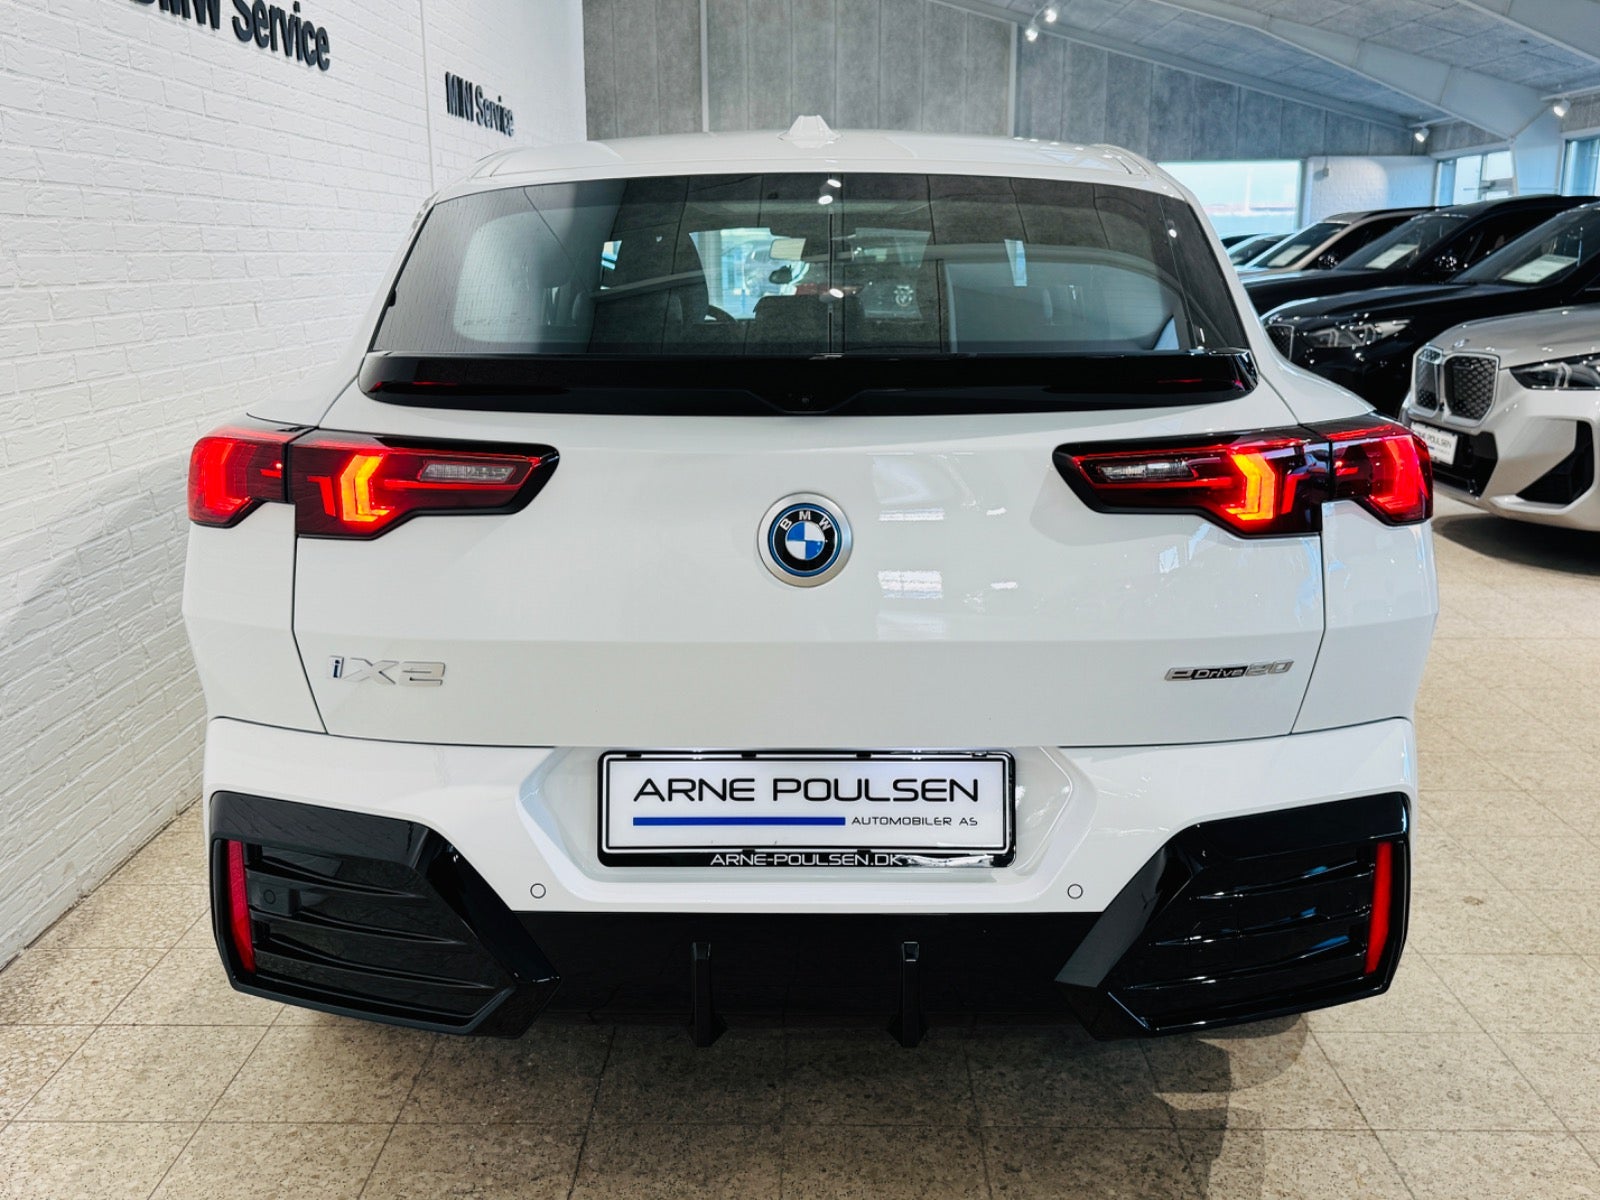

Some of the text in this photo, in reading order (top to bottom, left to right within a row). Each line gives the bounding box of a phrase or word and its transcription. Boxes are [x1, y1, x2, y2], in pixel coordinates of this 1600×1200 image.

[232, 0, 330, 71] Service
[475, 85, 514, 137] Service
[780, 510, 831, 531] BMW
[633, 778, 979, 802] ARNE POULSEN
[851, 816, 978, 826] AUTOMOBILER AS
[710, 853, 904, 866] ARNE-POULSEN.DK
